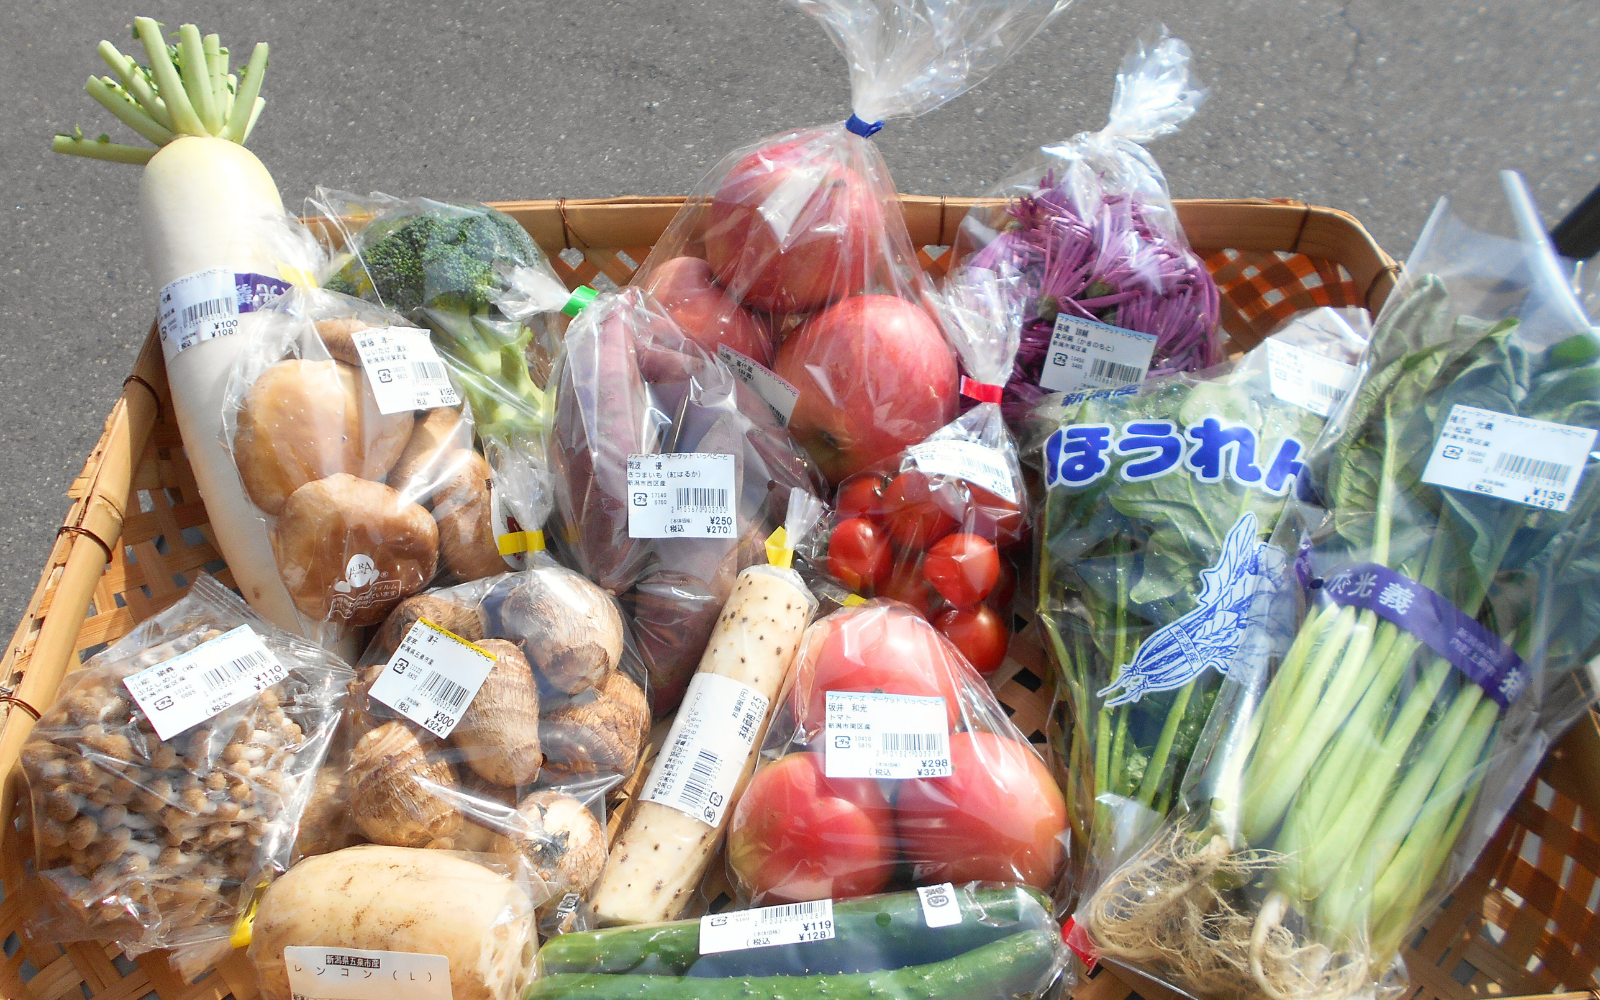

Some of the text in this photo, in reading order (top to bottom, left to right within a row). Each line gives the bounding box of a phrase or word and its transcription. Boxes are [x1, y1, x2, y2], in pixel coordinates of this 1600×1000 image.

[214, 319, 238, 330] ¥100
[1533, 486, 1566, 502] ¥138
[709, 516, 733, 526] ¥250
[411, 626, 425, 638] 中川
[253, 665, 282, 681] ¥110
[828, 702, 844, 712] 坂井
[434, 710, 454, 727] ¥300
[921, 758, 948, 768] ¥298
[802, 919, 832, 932] ¥119
[325, 955, 381, 969] 新潟県五泉市産
